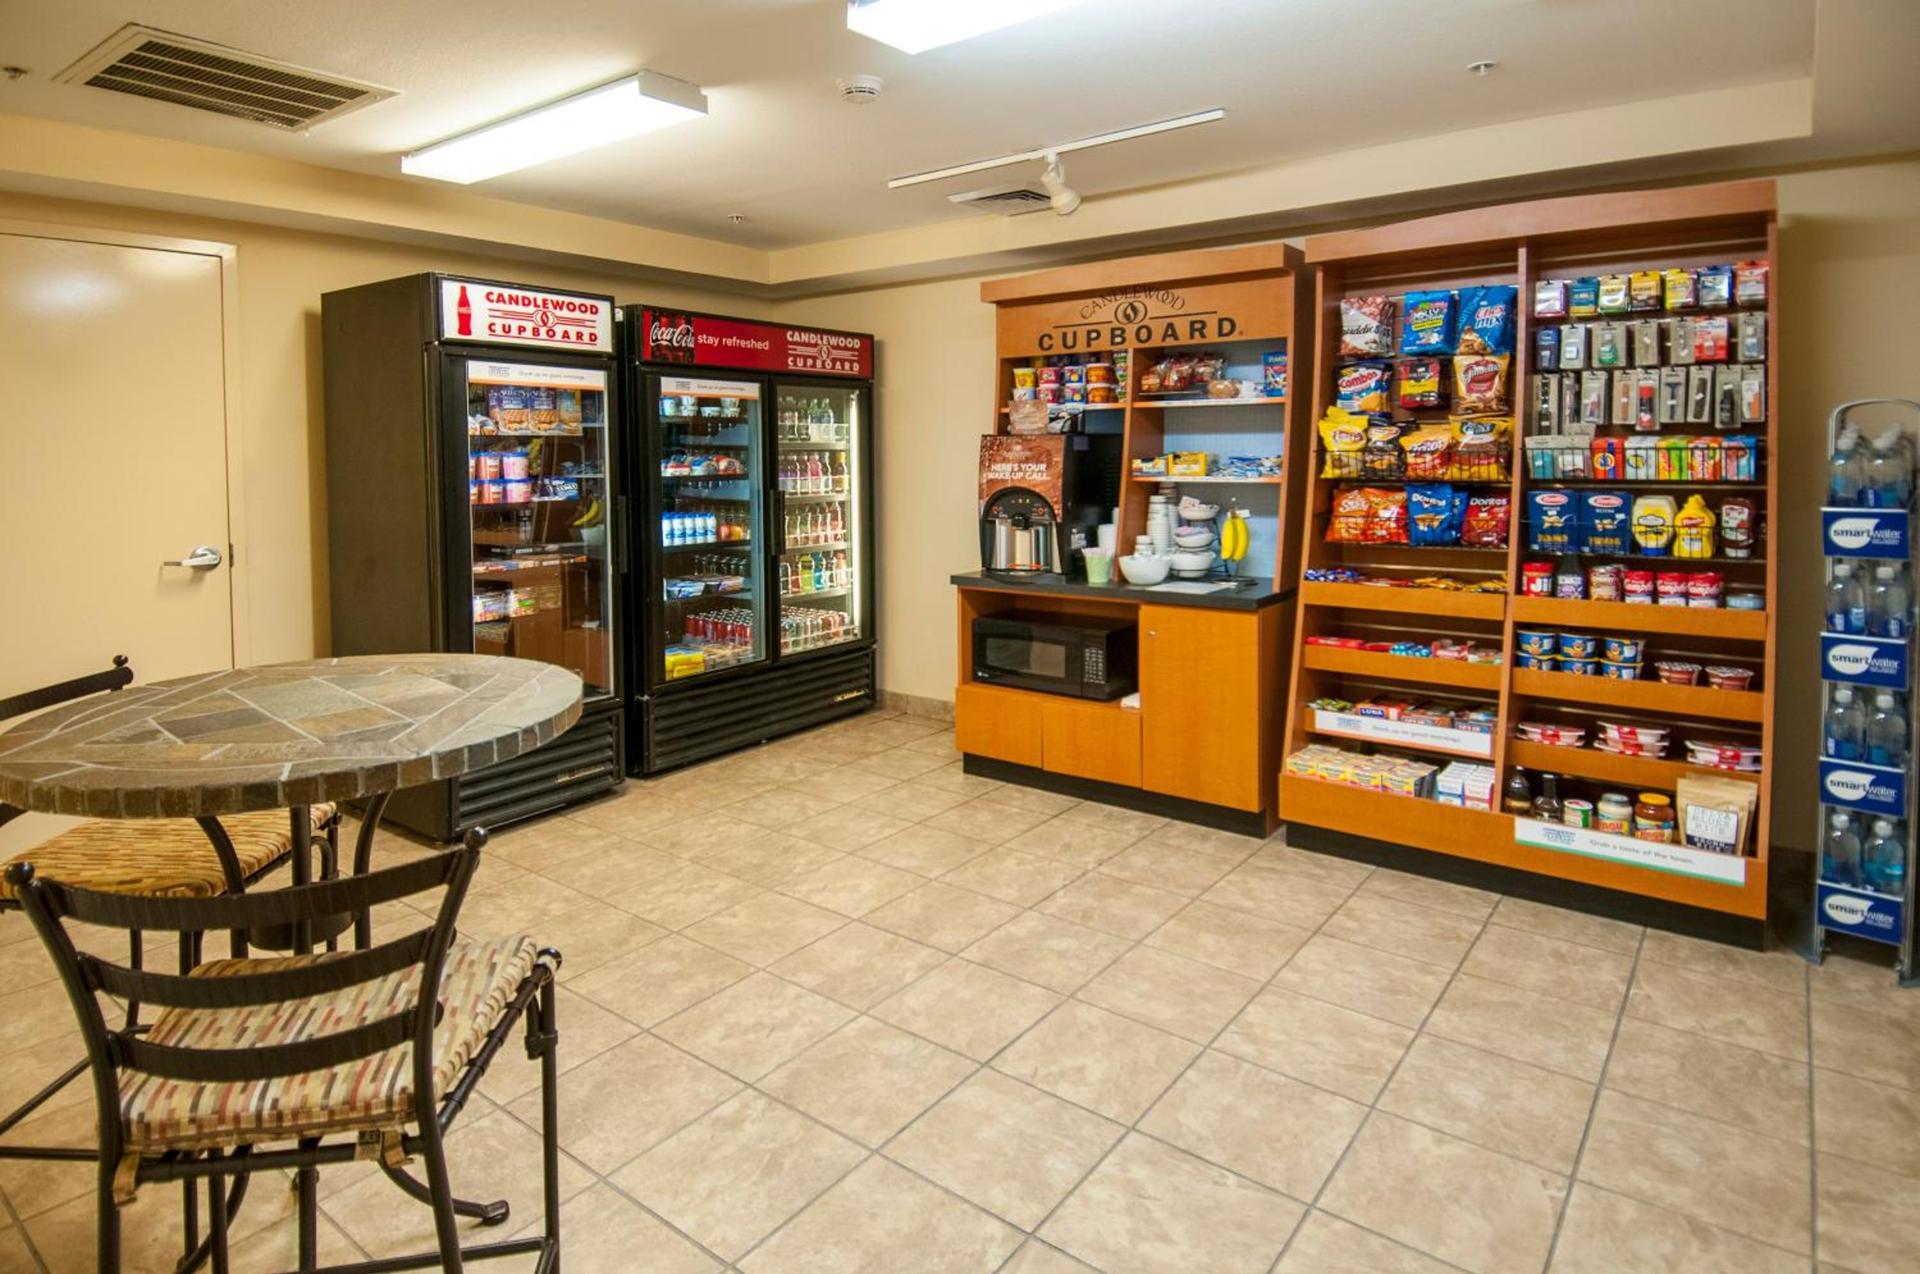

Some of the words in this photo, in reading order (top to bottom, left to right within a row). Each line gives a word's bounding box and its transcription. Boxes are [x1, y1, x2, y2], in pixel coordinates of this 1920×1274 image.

[485, 291, 599, 315] CANDLEWOOD
[1080, 285, 1186, 320] CANDLEWOOD
[487, 322, 598, 342] CUPBOARD
[650, 321, 695, 348] Coca-Cola
[786, 331, 861, 348] CANDLEWOOD
[1038, 317, 1237, 351] CUPBOARD
[697, 334, 720, 347] stay
[722, 336, 769, 350] refreshed
[787, 356, 860, 372] CUPBOARD
[1339, 371, 1378, 388] Combos
[1020, 463, 1047, 472] YOUR
[1469, 497, 1507, 506] Doritos
